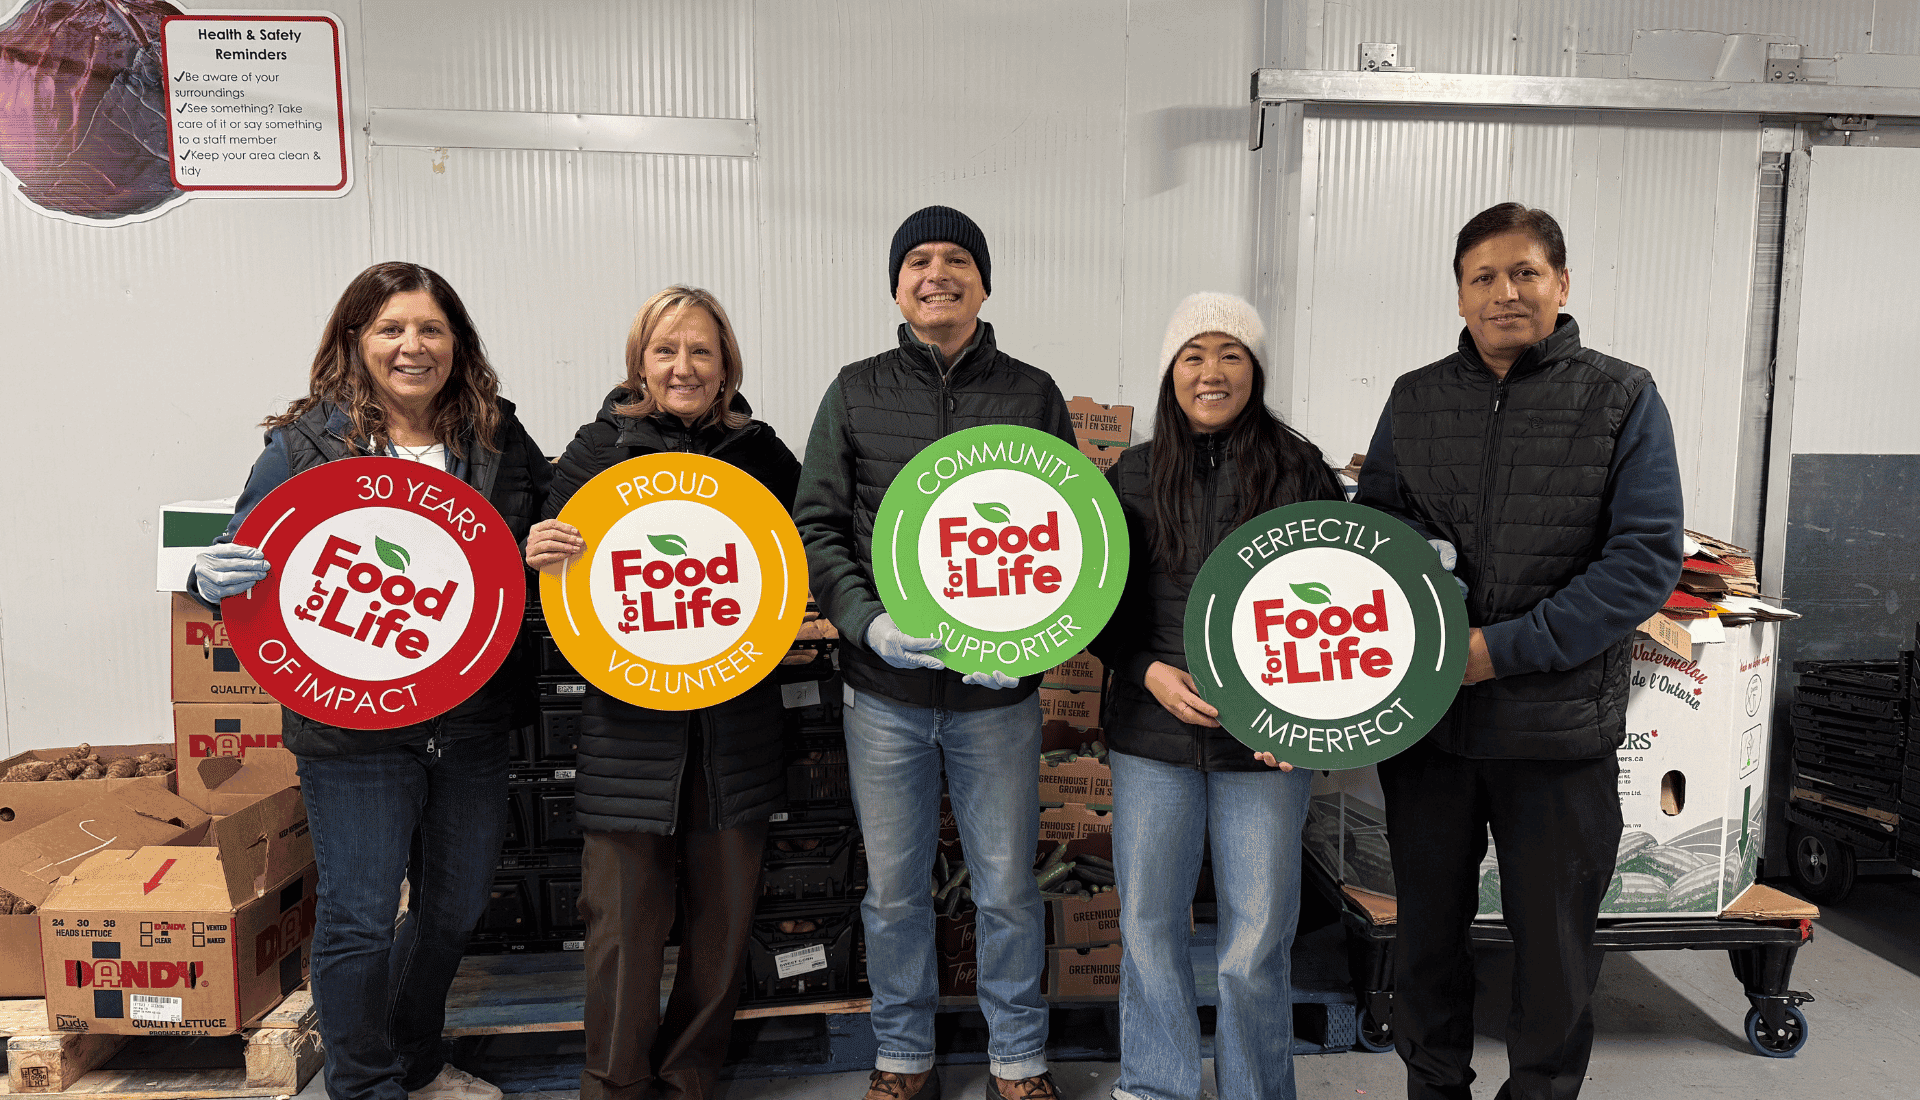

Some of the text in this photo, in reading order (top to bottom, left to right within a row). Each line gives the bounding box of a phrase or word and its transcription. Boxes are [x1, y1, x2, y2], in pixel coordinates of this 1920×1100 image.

[198, 28, 302, 43] Health & Safety
[215, 48, 287, 60] Reminders
[185, 71, 280, 84] Be aware of your
[174, 87, 245, 99] surroundings
[187, 103, 303, 115] See something? Take
[177, 118, 323, 131] care of it or say something
[178, 134, 277, 145] to a staff member
[190, 151, 321, 163] Keep your area clean &
[181, 165, 201, 177] tidy
[1089, 422, 1099, 430] EN
[1100, 423, 1122, 433] SERRE
[917, 441, 1079, 495] COMMUNITY
[616, 470, 719, 506] PROUD
[356, 474, 487, 542] 30 YEARS
[939, 511, 1060, 558] Food
[1237, 518, 1391, 569] PERFECTLY
[611, 543, 739, 592] Food
[311, 534, 459, 622] Food
[943, 554, 1062, 599] for Life
[618, 587, 741, 634] for Life
[1253, 588, 1389, 643] Food
[294, 580, 430, 660] for Life
[930, 614, 1082, 664] SUPPORTER
[608, 641, 763, 694] VOLUNTEER
[1261, 636, 1393, 686] for Life
[258, 639, 418, 715] OF IMPACT
[1072, 669, 1093, 678] SERRE
[210, 685, 257, 696] QUALITY
[1631, 671, 1701, 711] de l'Ontario
[1057, 708, 1066, 716] EN
[1068, 709, 1090, 718] SERRE
[1250, 697, 1414, 753] IMPERFECT
[1039, 775, 1088, 786] GREENHOUSE
[1059, 785, 1087, 795] GROWN
[1095, 787, 1105, 796] EN
[1040, 821, 1075, 831] ENHOUSE
[1046, 831, 1075, 840] GROWN
[1073, 909, 1121, 922] GREENHOU
[52, 918, 116, 928] 24 30 38
[56, 929, 112, 938] HEADS LETTUCE
[65, 960, 204, 989] DANDY
[1069, 964, 1120, 975] GREENHOUS
[1092, 975, 1120, 985] GROW
[56, 1016, 89, 1028] Duda
[132, 1018, 226, 1029] QUALITY LETTUCE
